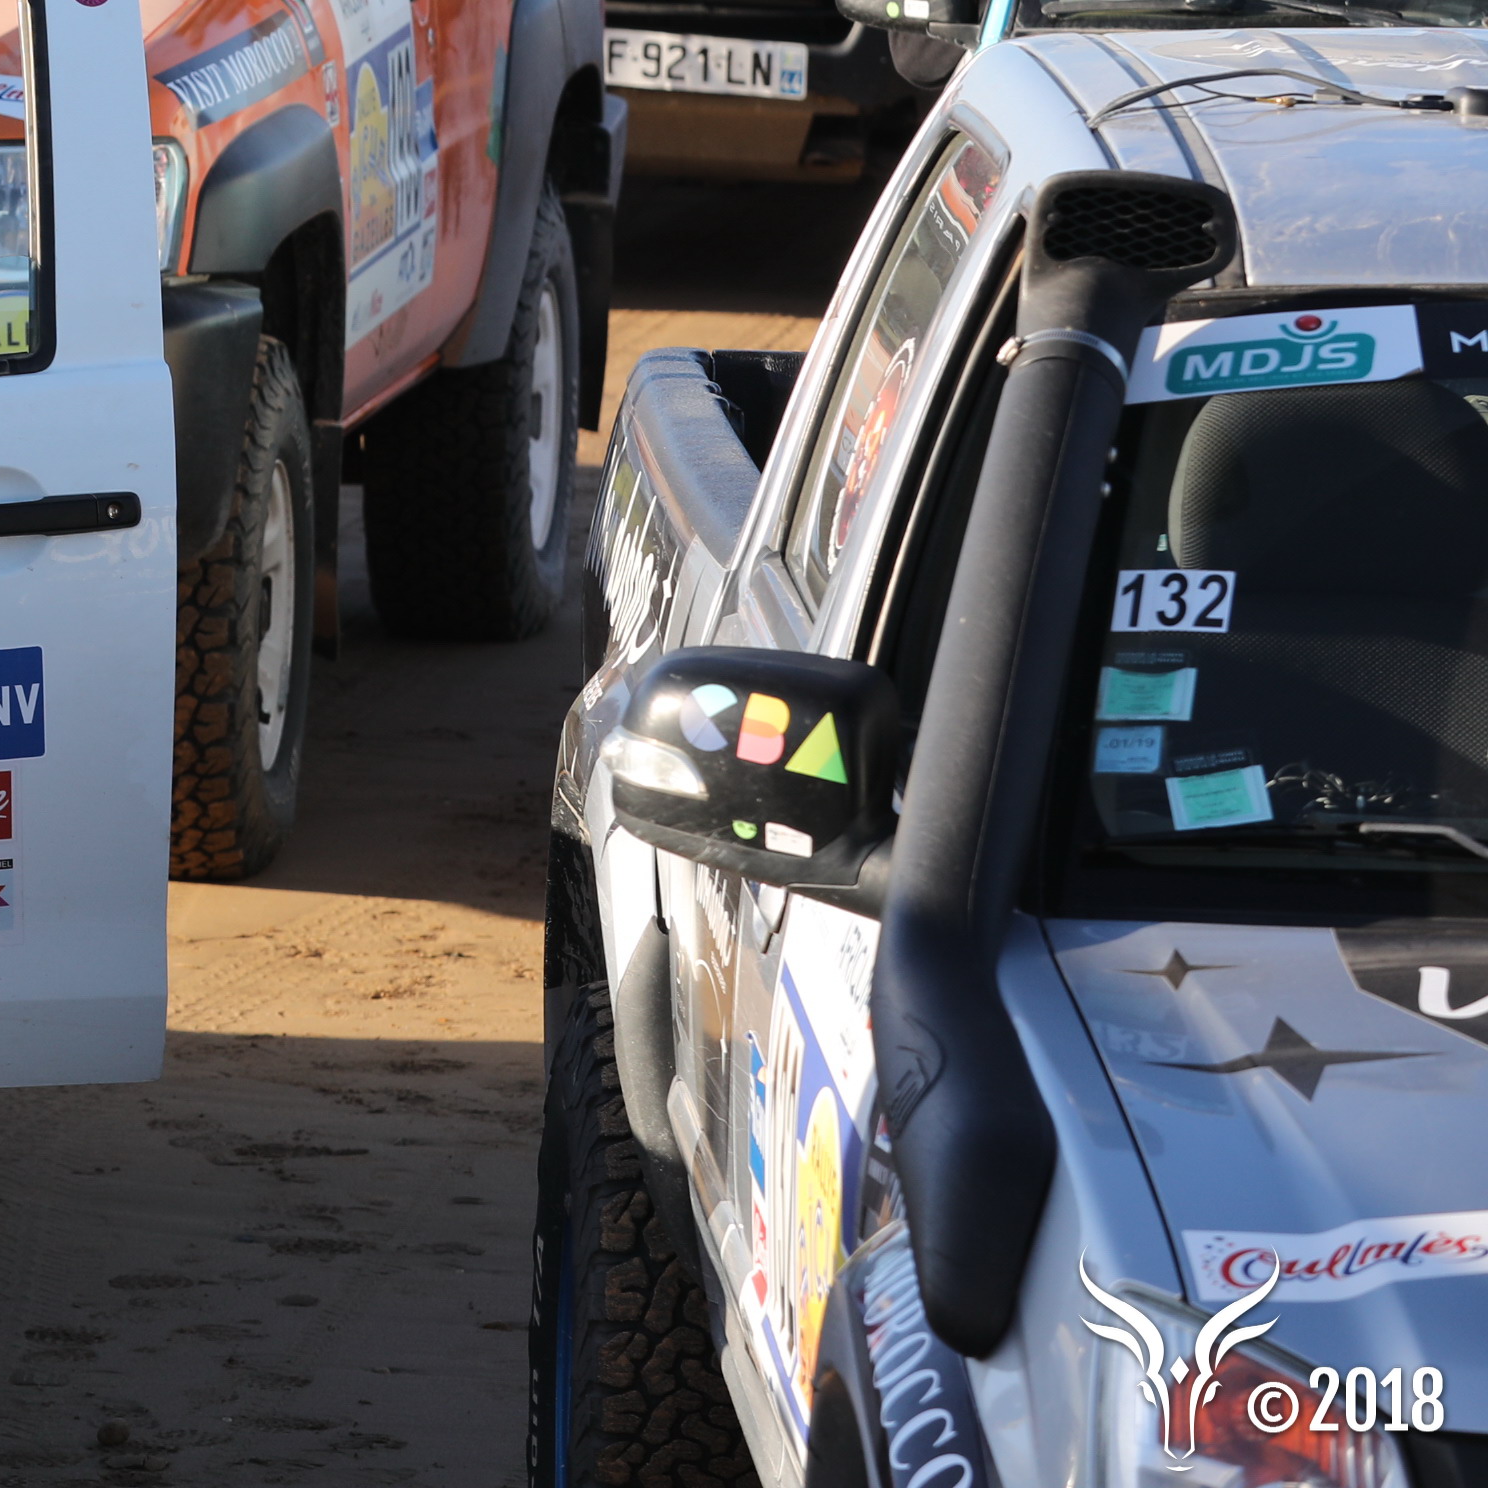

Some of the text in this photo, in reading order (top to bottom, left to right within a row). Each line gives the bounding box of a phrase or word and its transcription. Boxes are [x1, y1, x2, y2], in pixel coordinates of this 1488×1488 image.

[607, 37, 773, 89] F-921-LN
[1179, 340, 1361, 384] MDJS
[1121, 572, 1229, 628] 132
